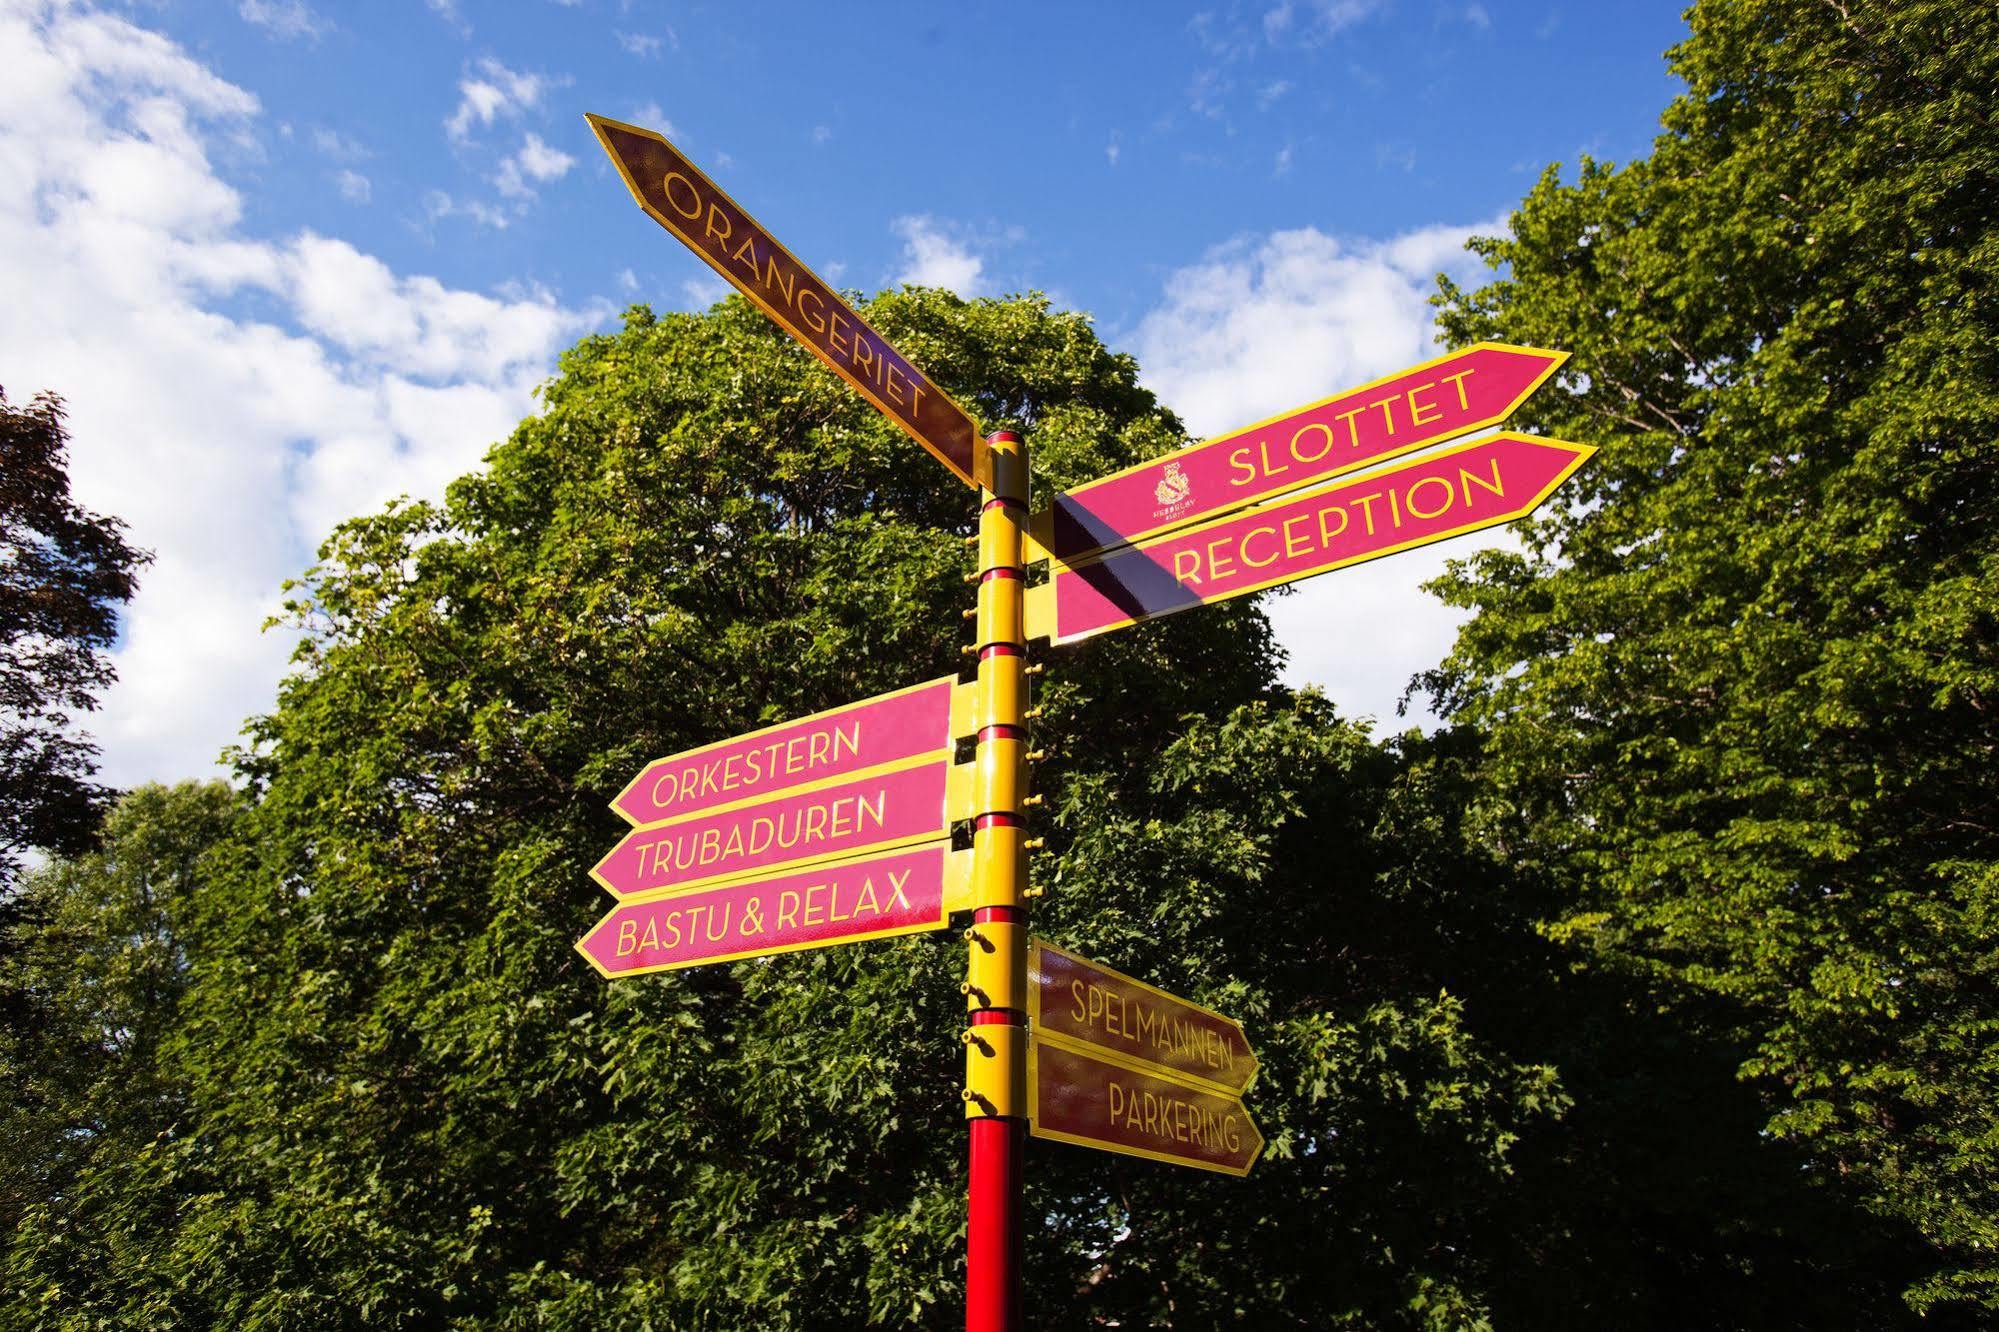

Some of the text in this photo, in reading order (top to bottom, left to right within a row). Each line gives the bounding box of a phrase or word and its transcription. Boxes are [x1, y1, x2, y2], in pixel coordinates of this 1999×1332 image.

[663, 171, 926, 418] ORANGERIET
[1229, 368, 1475, 486] SLOTTET
[1173, 458, 1505, 588] RECEPTION
[652, 721, 862, 808] ORKESTERN
[635, 790, 886, 879] TRUBADUREN
[615, 868, 912, 957] BASTU & RELAX
[1071, 979, 1233, 1072] SPELMANNEN
[1109, 1082, 1240, 1153] PARKERING
